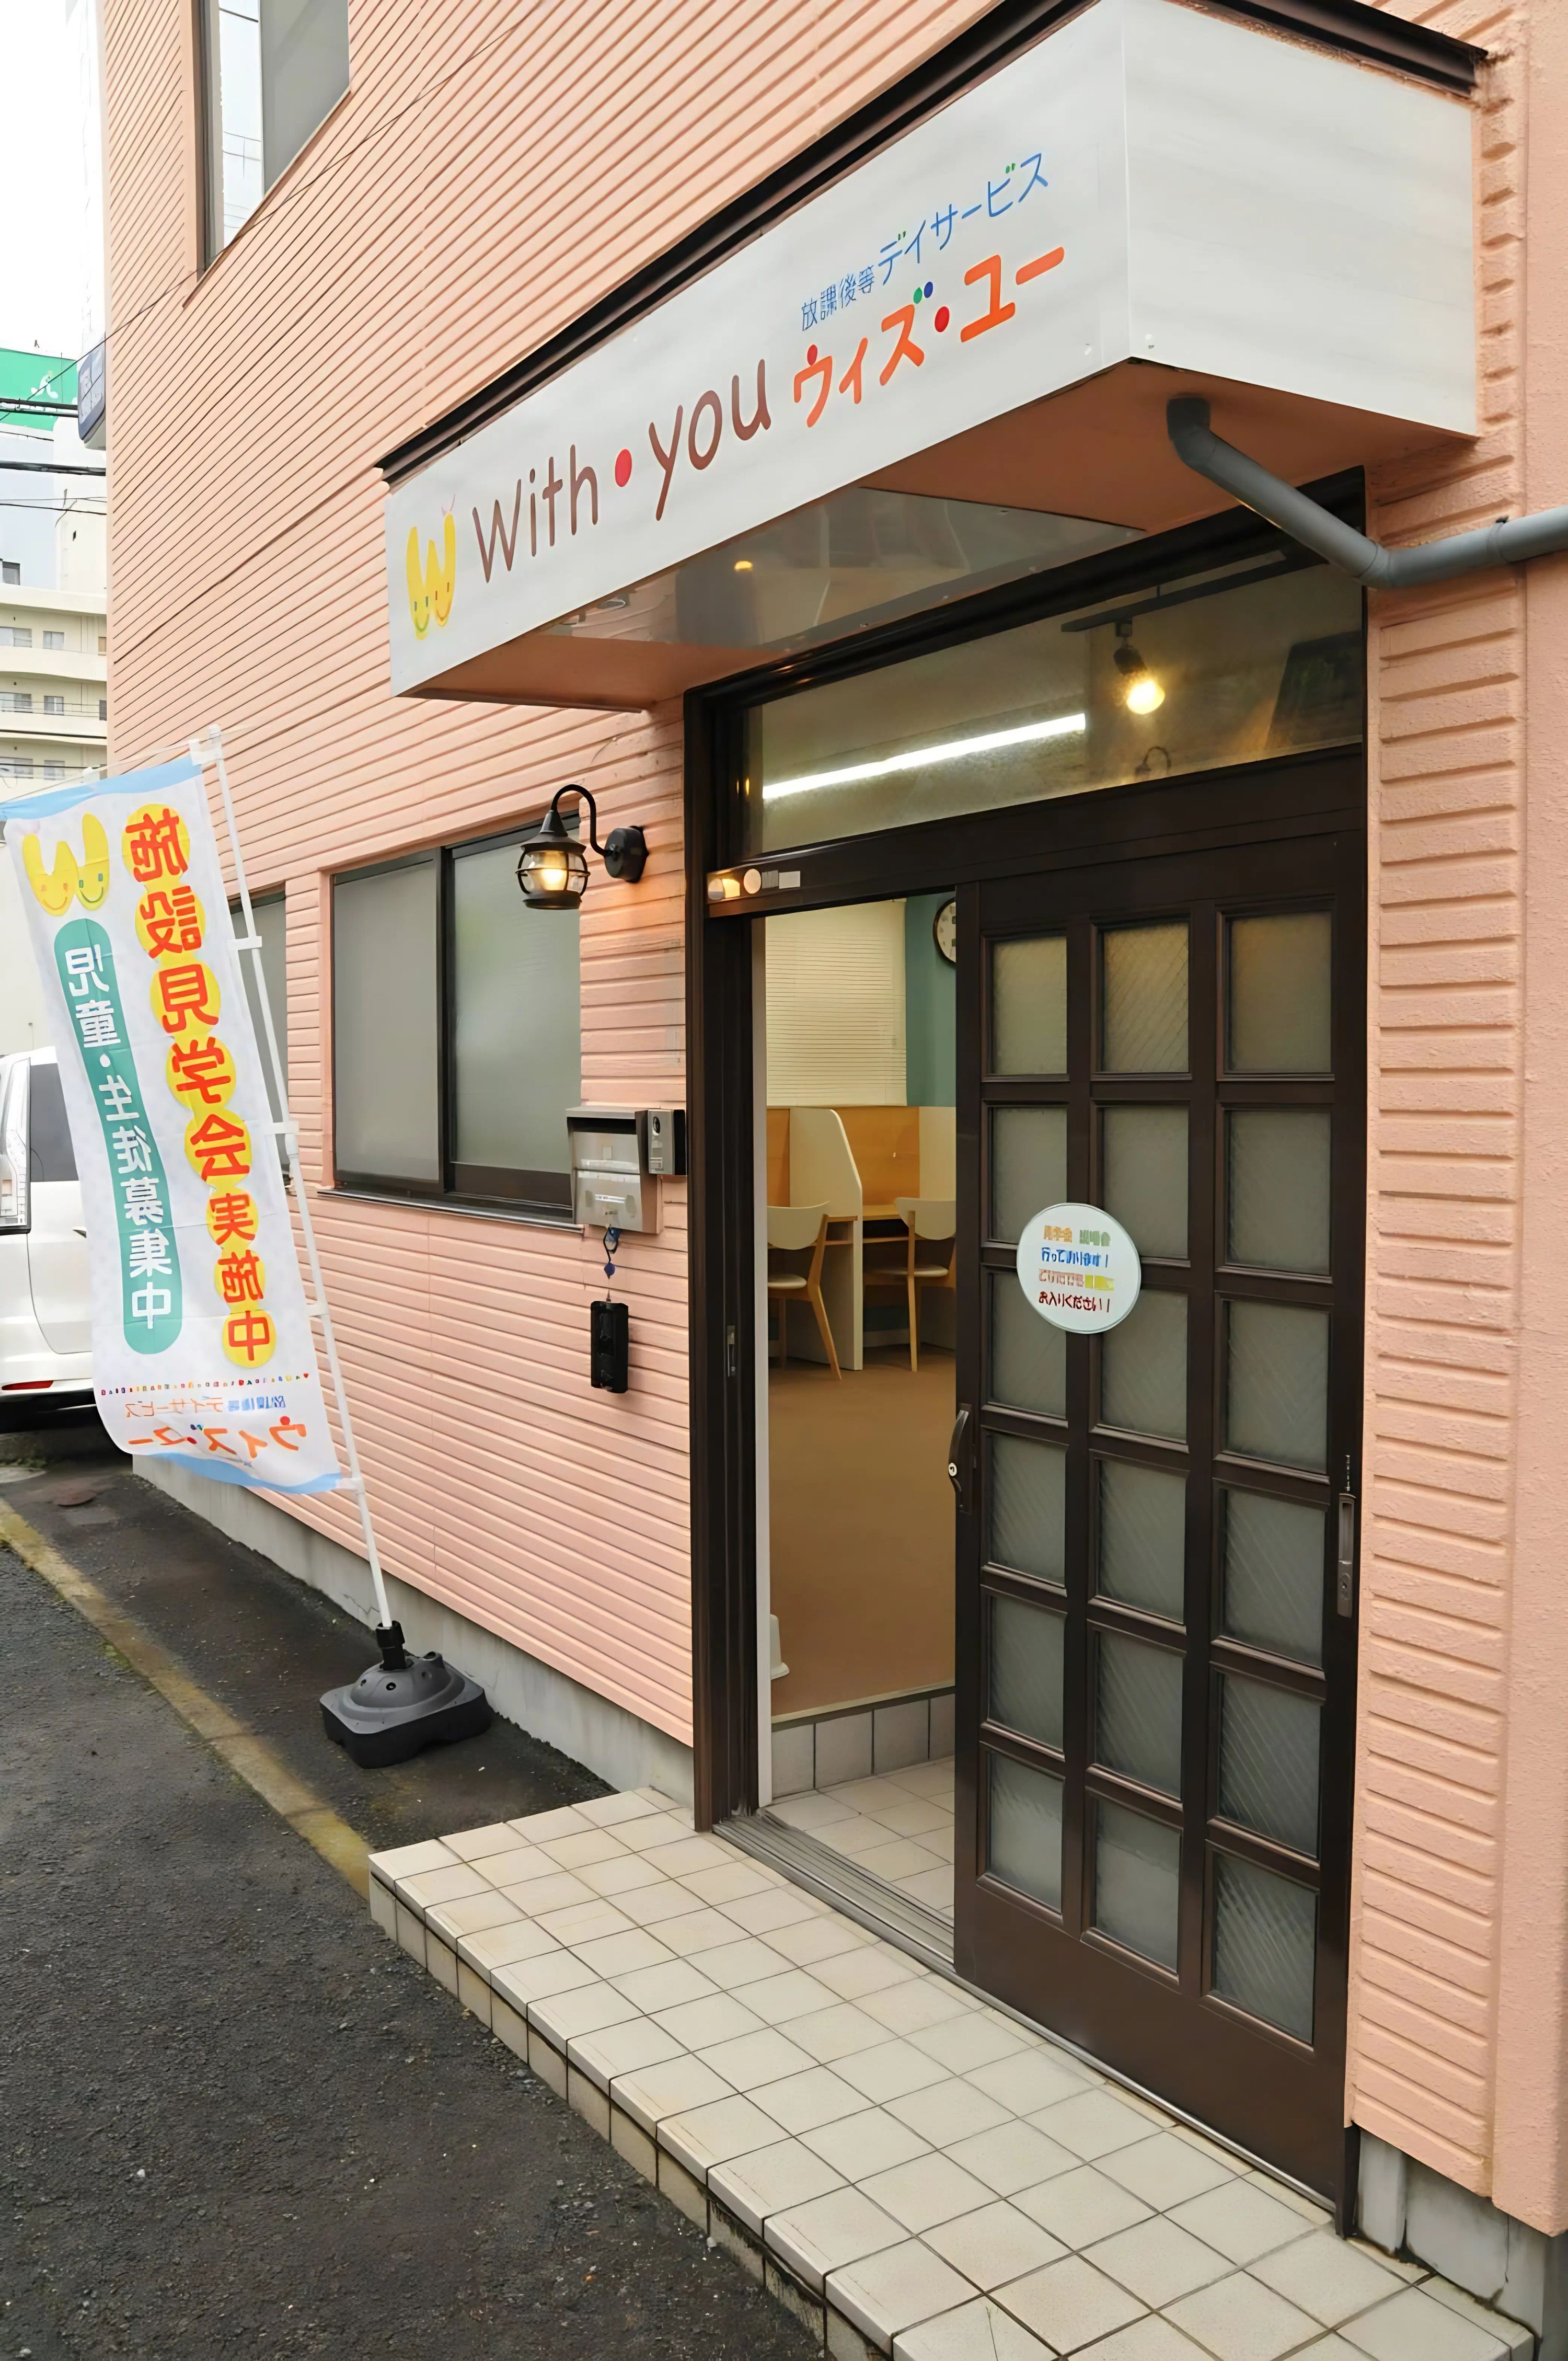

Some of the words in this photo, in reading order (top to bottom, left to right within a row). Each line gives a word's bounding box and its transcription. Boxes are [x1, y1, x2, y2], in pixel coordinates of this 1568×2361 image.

[801, 153, 1048, 331] 放課後等デイサービス
